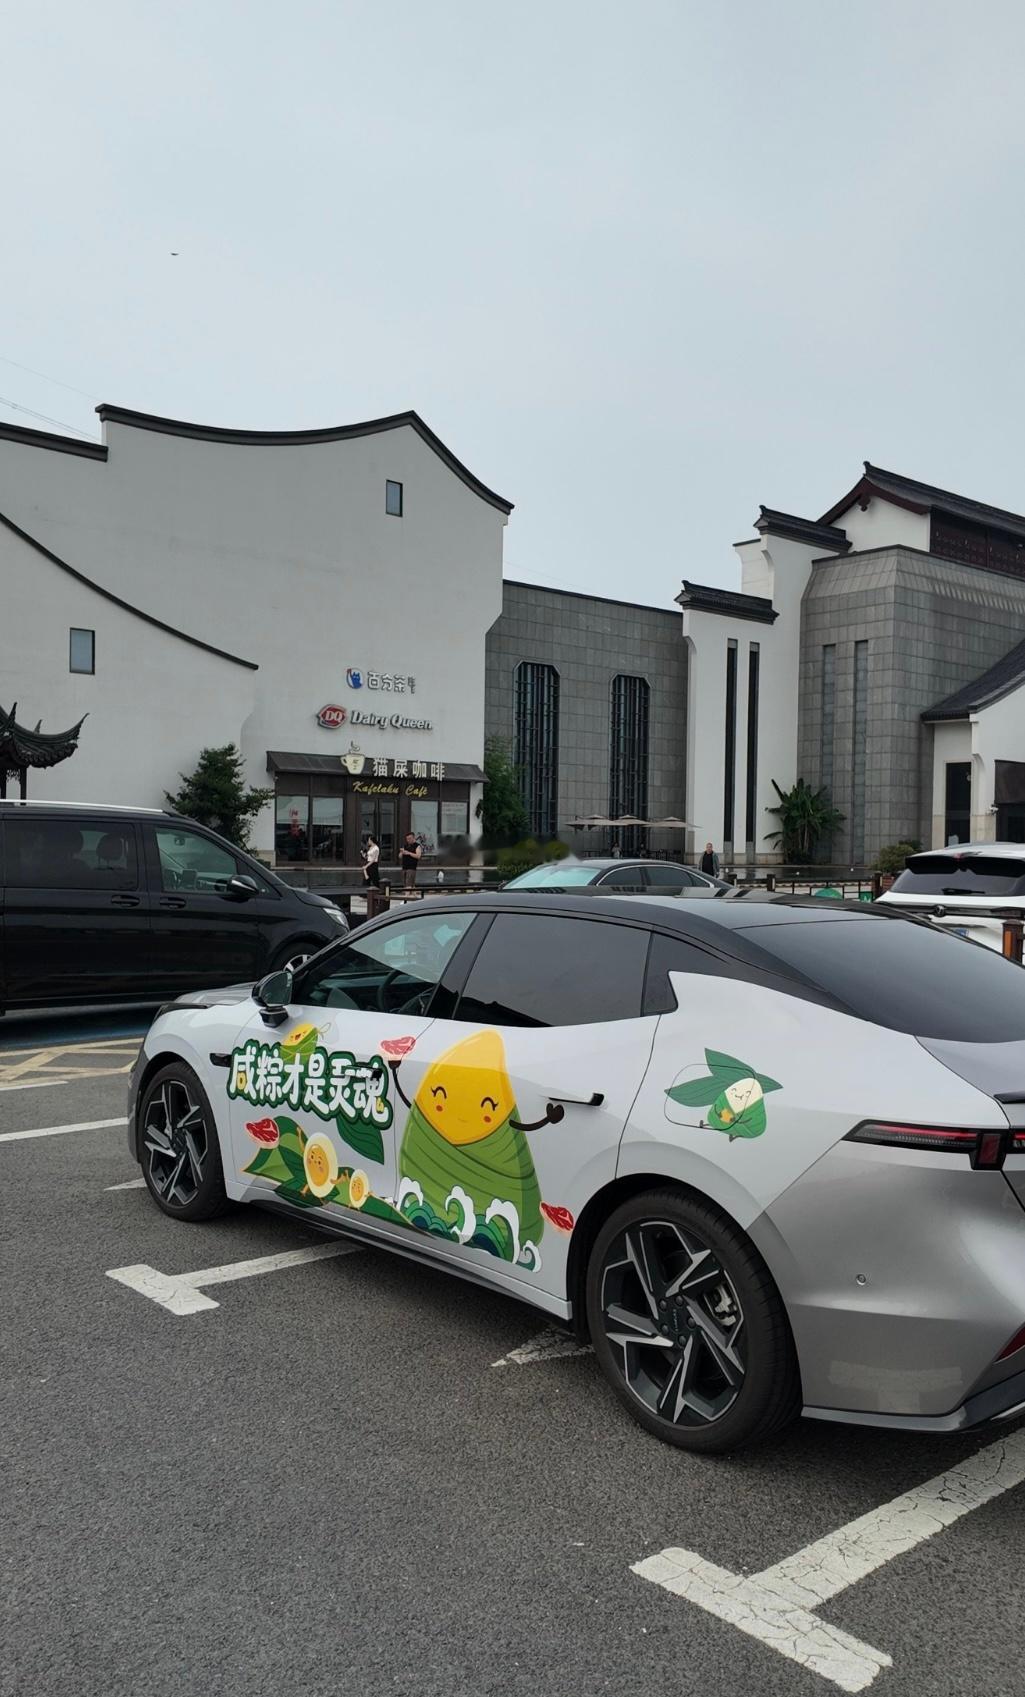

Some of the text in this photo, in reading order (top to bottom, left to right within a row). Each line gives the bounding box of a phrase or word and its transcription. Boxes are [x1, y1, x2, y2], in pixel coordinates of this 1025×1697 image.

[367, 671, 406, 693] 百分茶
[324, 709, 343, 722] DQ
[351, 710, 432, 730] Dairy Queen
[372, 757, 445, 781] 猫屎咖啡
[353, 780, 400, 795] Kafelaku
[229, 1045, 389, 1123] 咸粽才是灵魂
